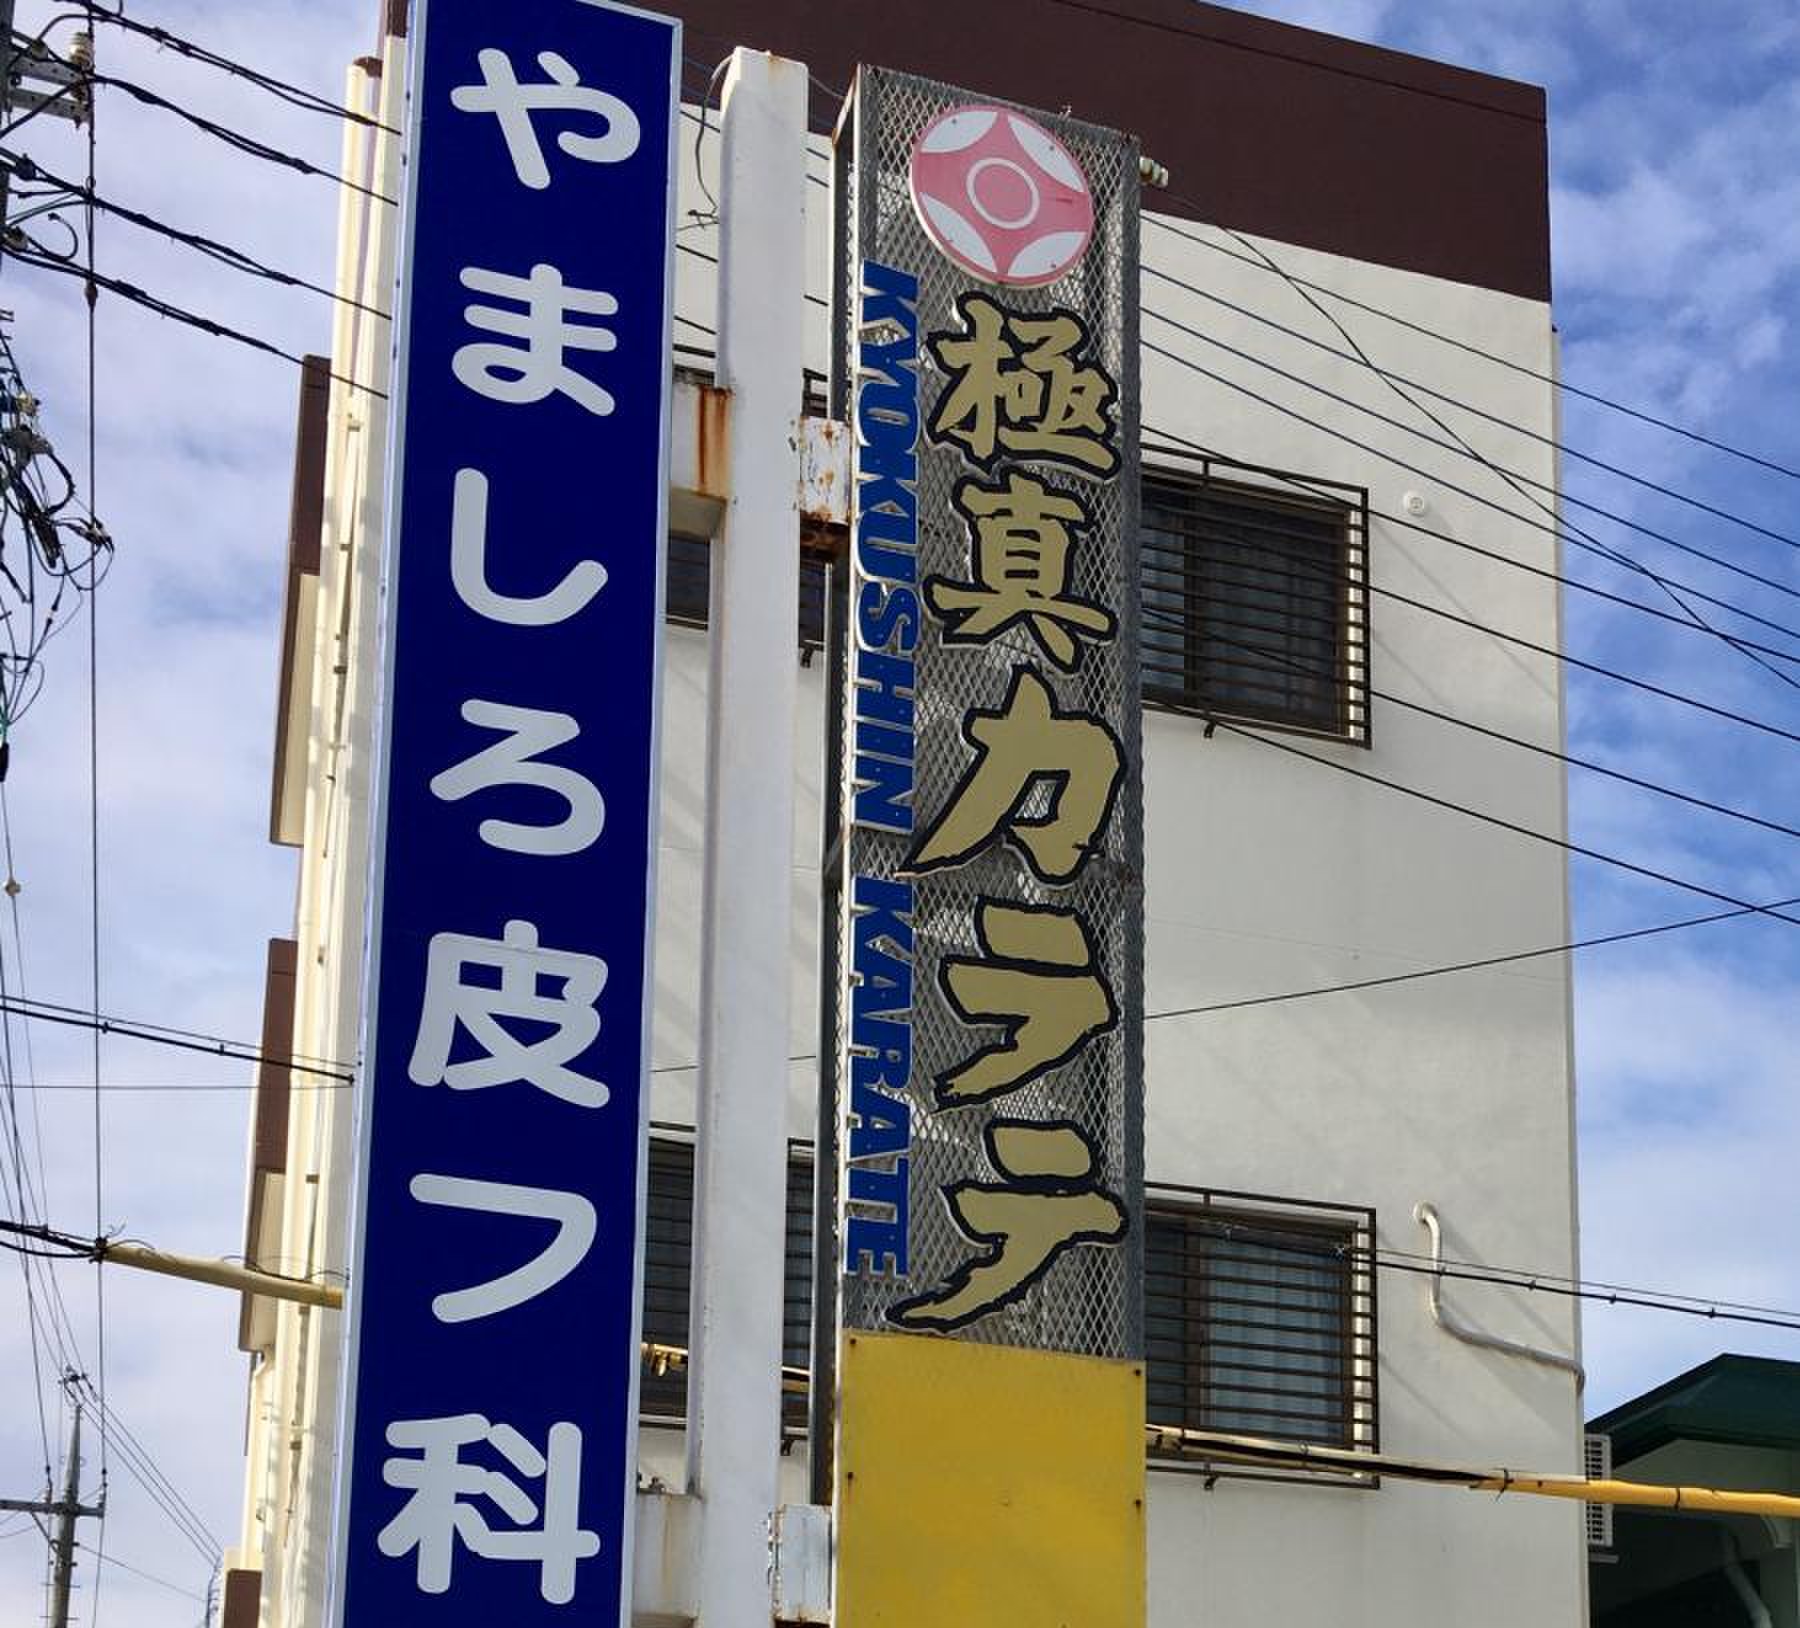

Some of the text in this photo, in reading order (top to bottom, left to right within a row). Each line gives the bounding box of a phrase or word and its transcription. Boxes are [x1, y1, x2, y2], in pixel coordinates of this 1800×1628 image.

[378, 47, 641, 1606] やましろ皮フ科
[846, 260, 920, 1278] KYOKUSHIN KARATE
[885, 292, 1128, 1332] 極真カラテ
